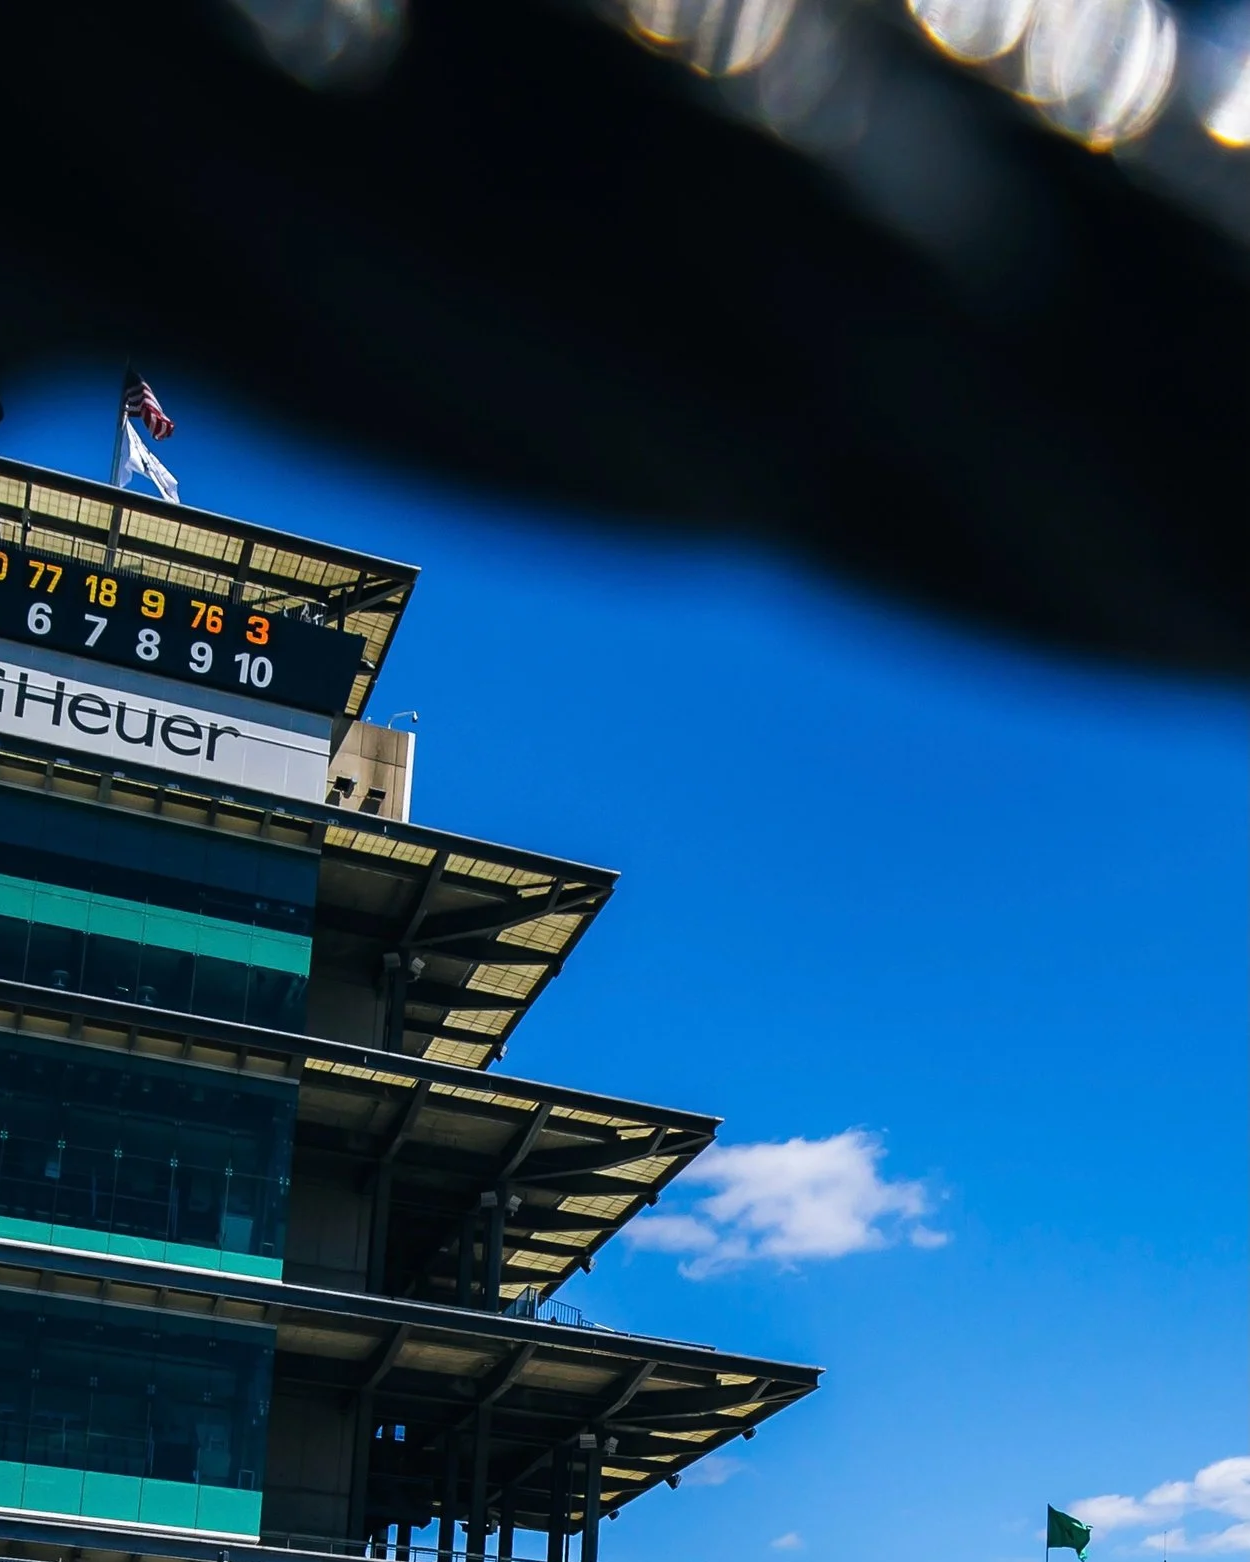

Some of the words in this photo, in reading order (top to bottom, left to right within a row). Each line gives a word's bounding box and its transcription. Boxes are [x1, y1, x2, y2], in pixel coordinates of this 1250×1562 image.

[27, 602, 52, 635] 6
[84, 614, 108, 647] 7
[135, 628, 161, 661] 8
[188, 641, 213, 674] 9
[234, 652, 273, 688] 10
[28, 560, 63, 593] 77
[85, 575, 117, 608] 18
[141, 589, 165, 619] 9
[190, 600, 224, 634] 76
[246, 616, 270, 645] 3
